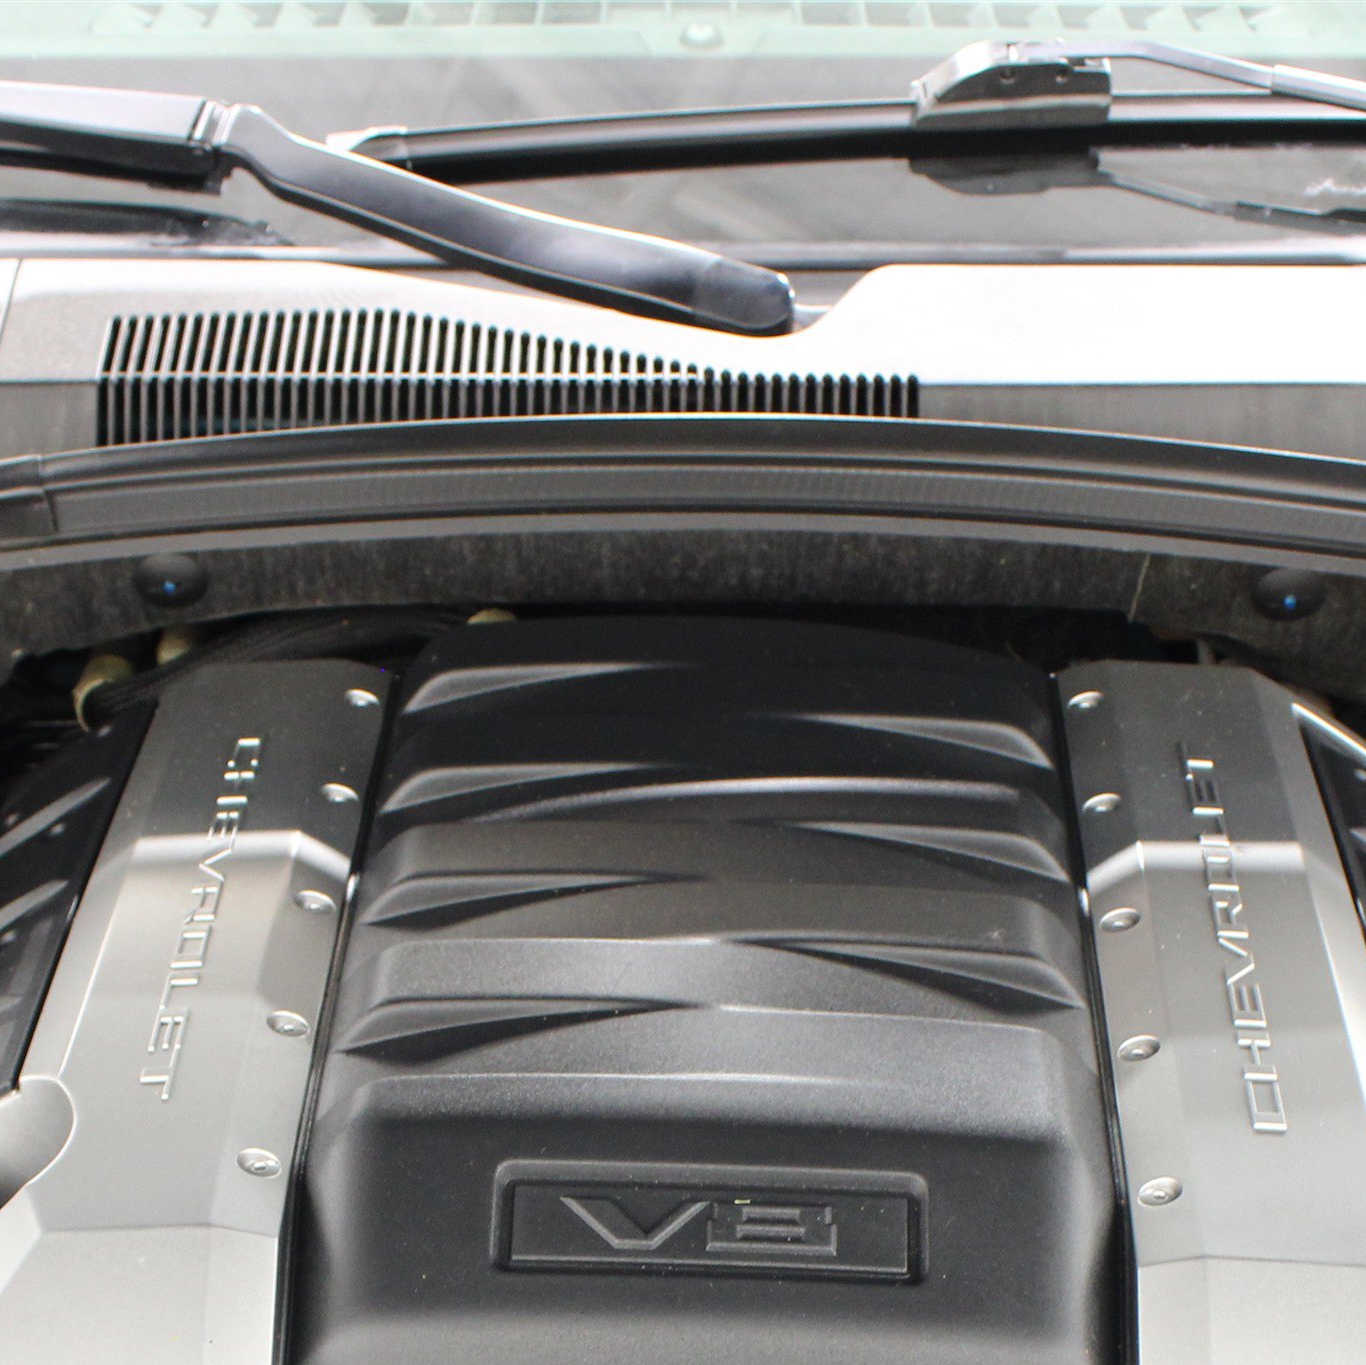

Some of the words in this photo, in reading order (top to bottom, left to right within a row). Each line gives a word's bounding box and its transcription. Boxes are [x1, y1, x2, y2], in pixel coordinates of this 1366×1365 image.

[139, 736, 262, 1102] CHEVROLET
[1178, 740, 1288, 1133] CHEVROLET
[559, 1197, 839, 1257] V8
